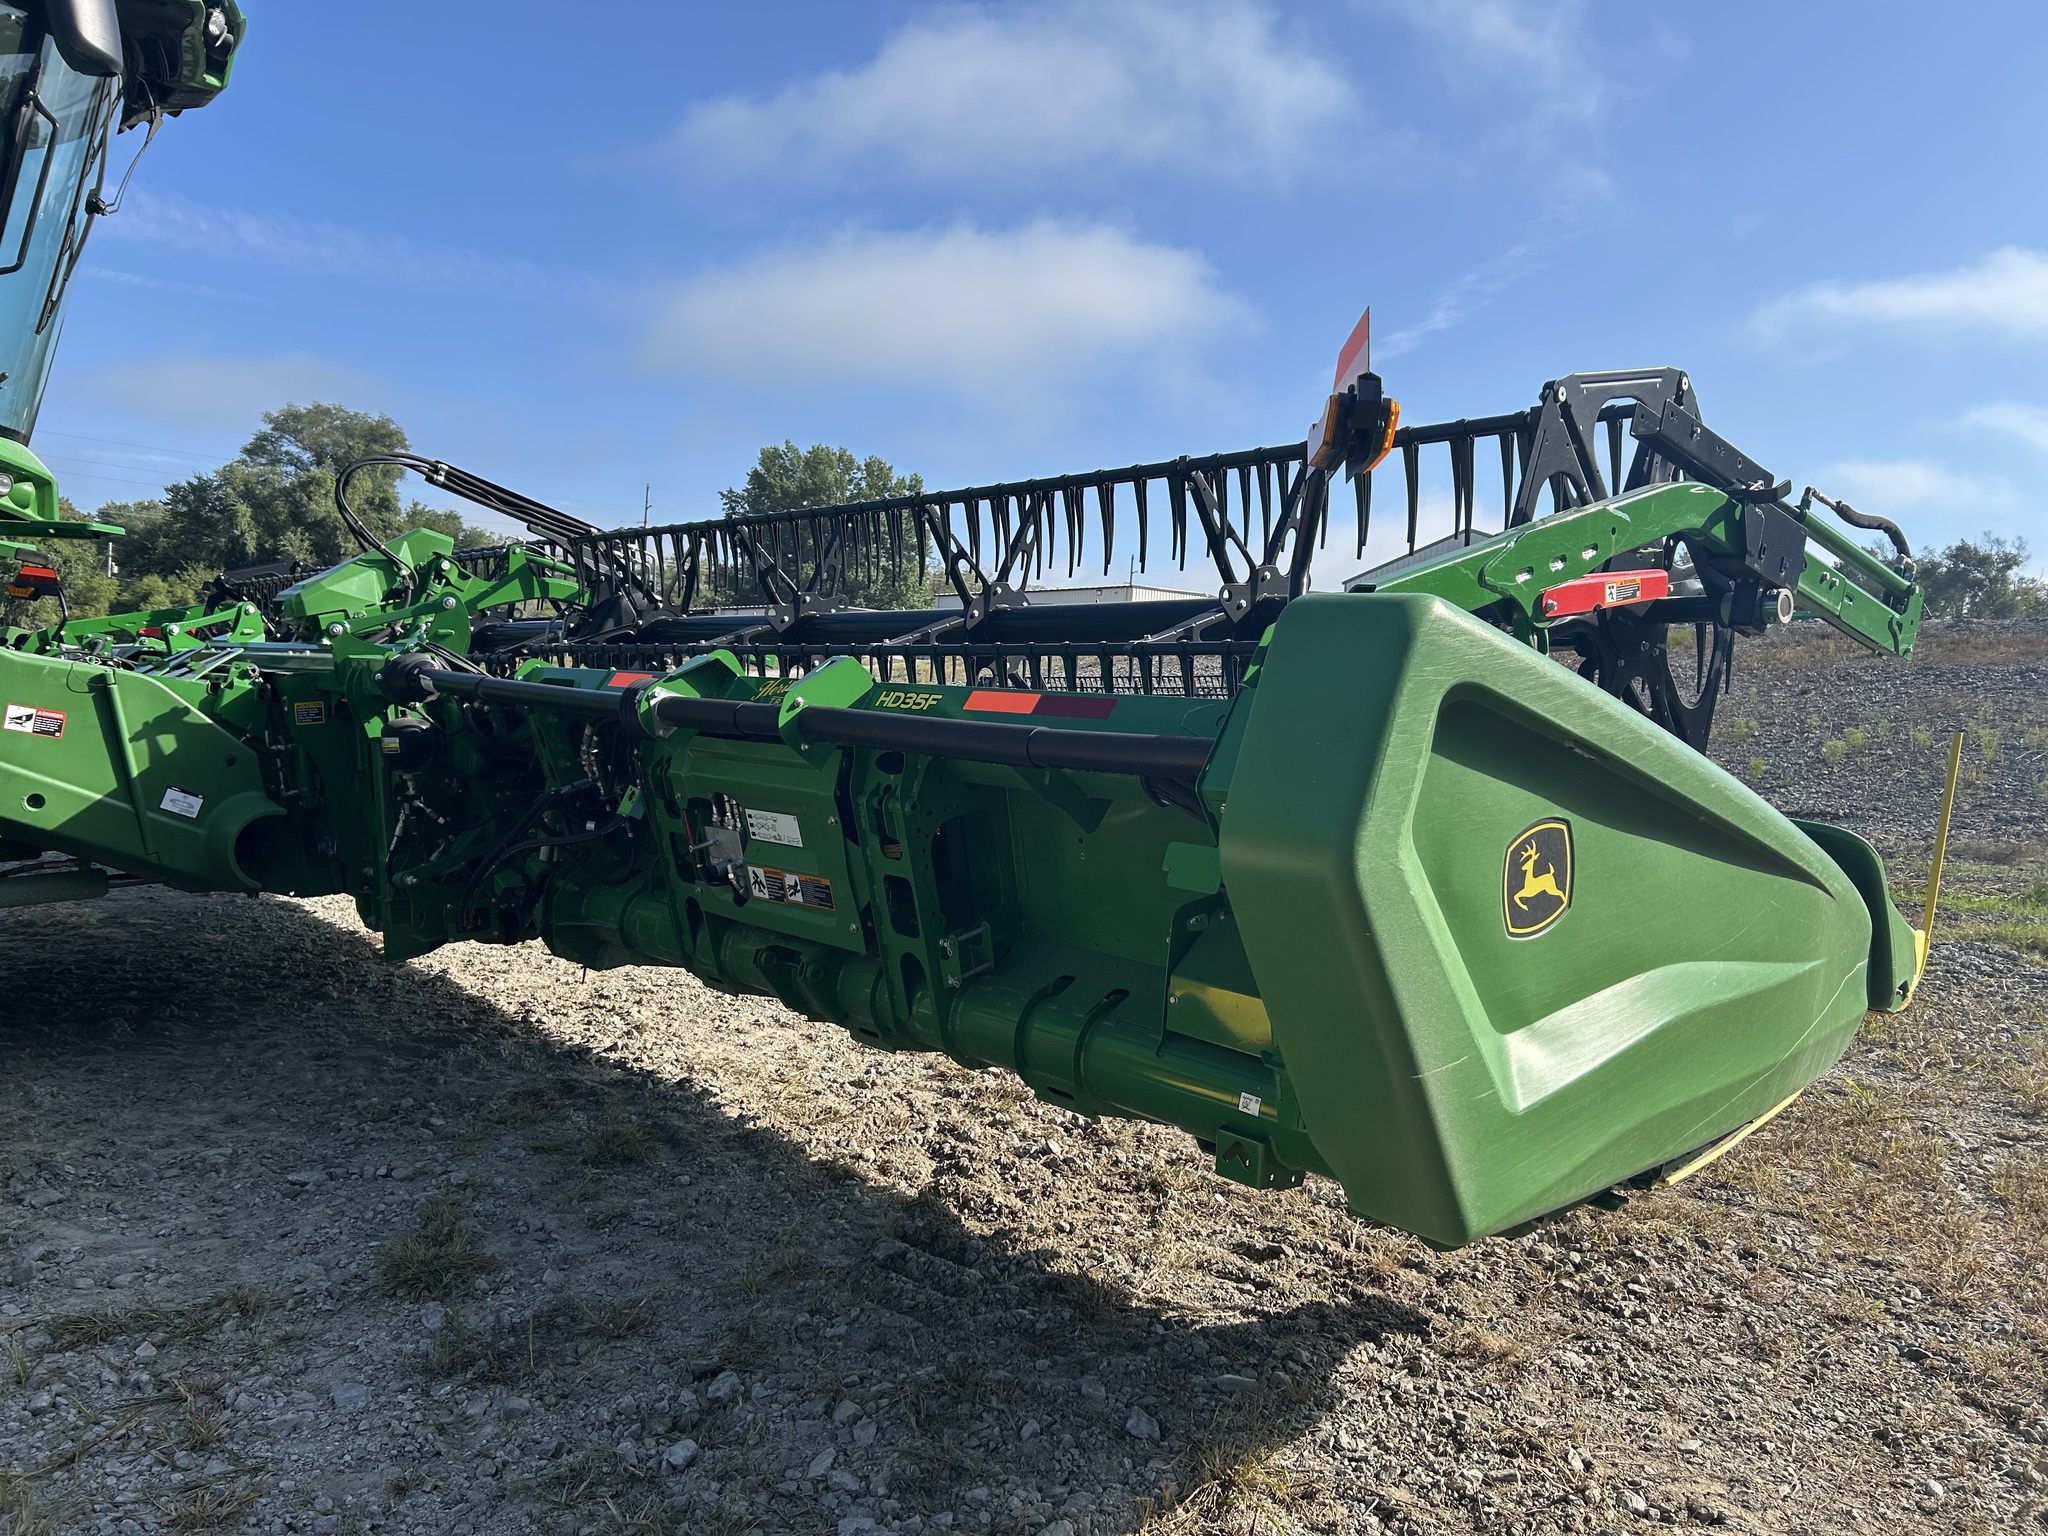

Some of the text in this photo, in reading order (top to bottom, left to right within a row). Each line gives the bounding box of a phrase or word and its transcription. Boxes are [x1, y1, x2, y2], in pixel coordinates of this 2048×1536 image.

[751, 678, 794, 701] Heri
[875, 691, 943, 710] HD35F
[42, 710, 64, 719] DANGER
